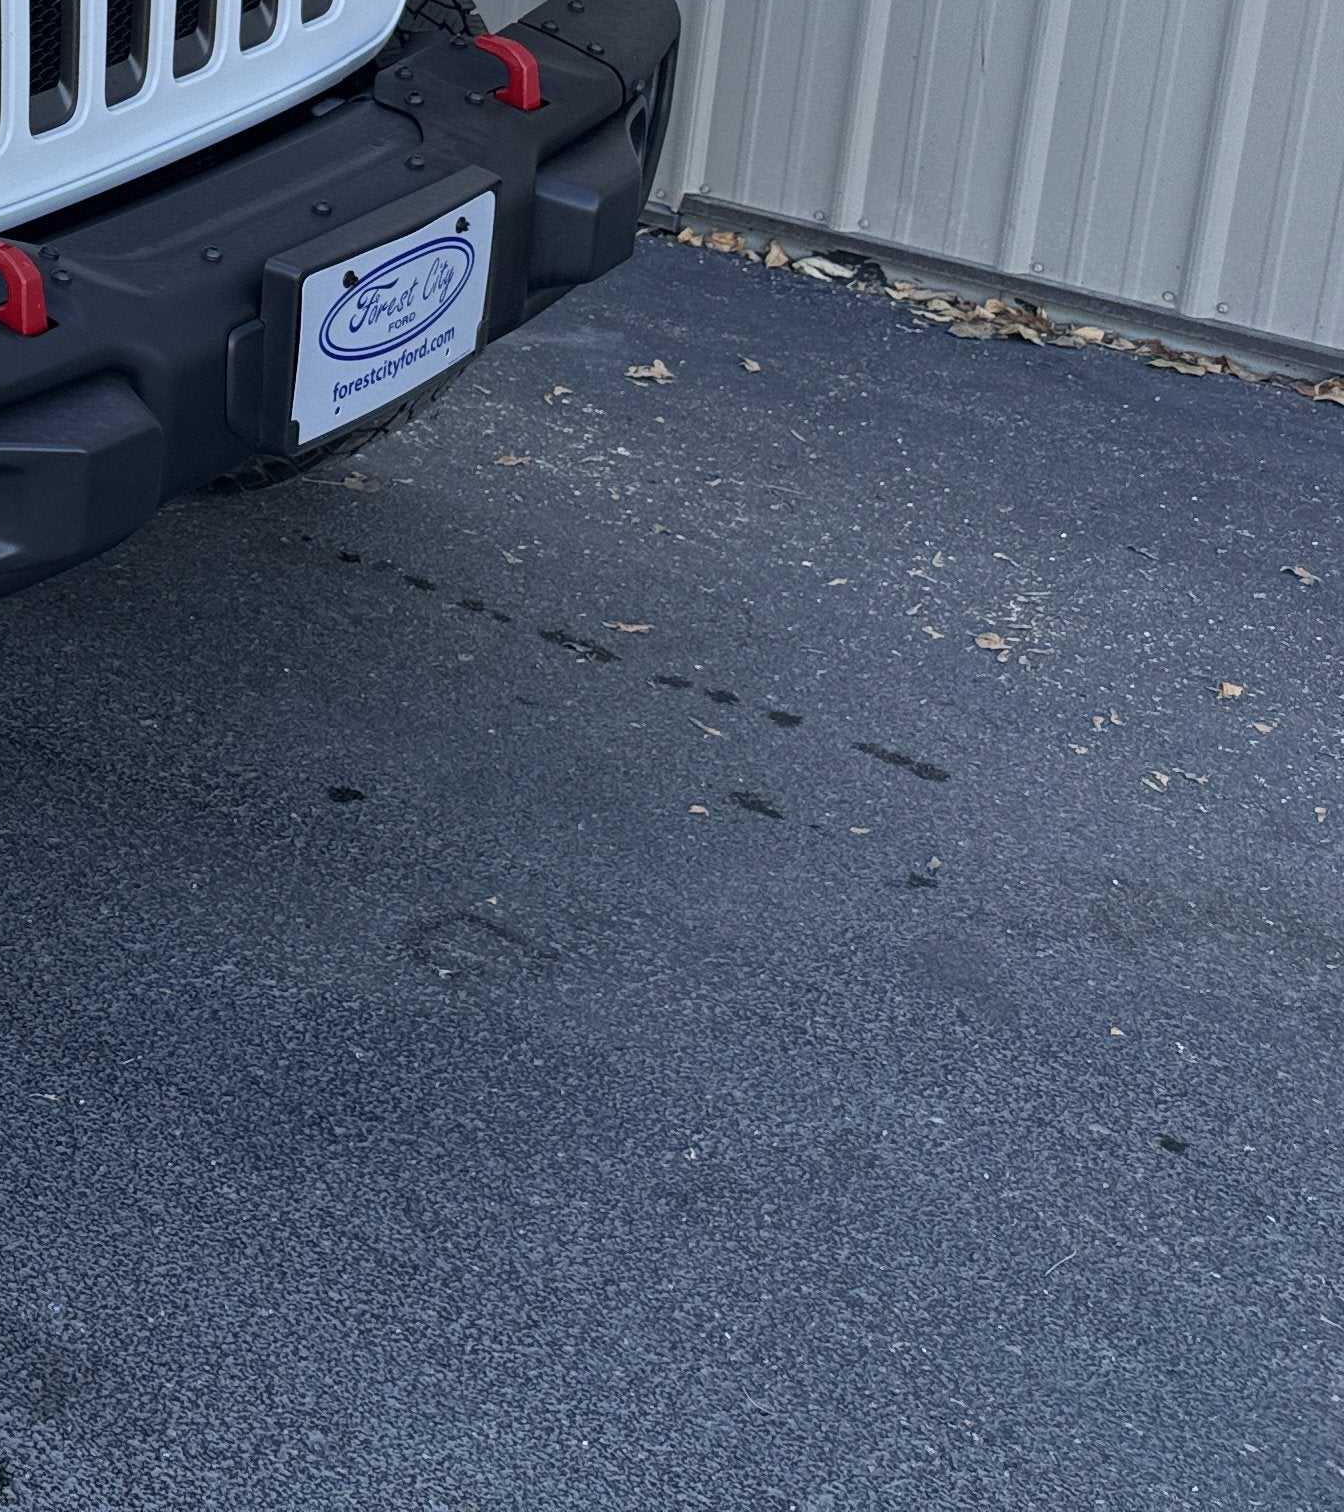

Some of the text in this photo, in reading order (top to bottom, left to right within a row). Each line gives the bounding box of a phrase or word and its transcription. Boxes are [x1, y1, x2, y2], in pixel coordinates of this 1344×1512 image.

[349, 257, 454, 333] Forest City
[388, 312, 416, 332] FORD
[332, 327, 455, 402] forestcityford.com
